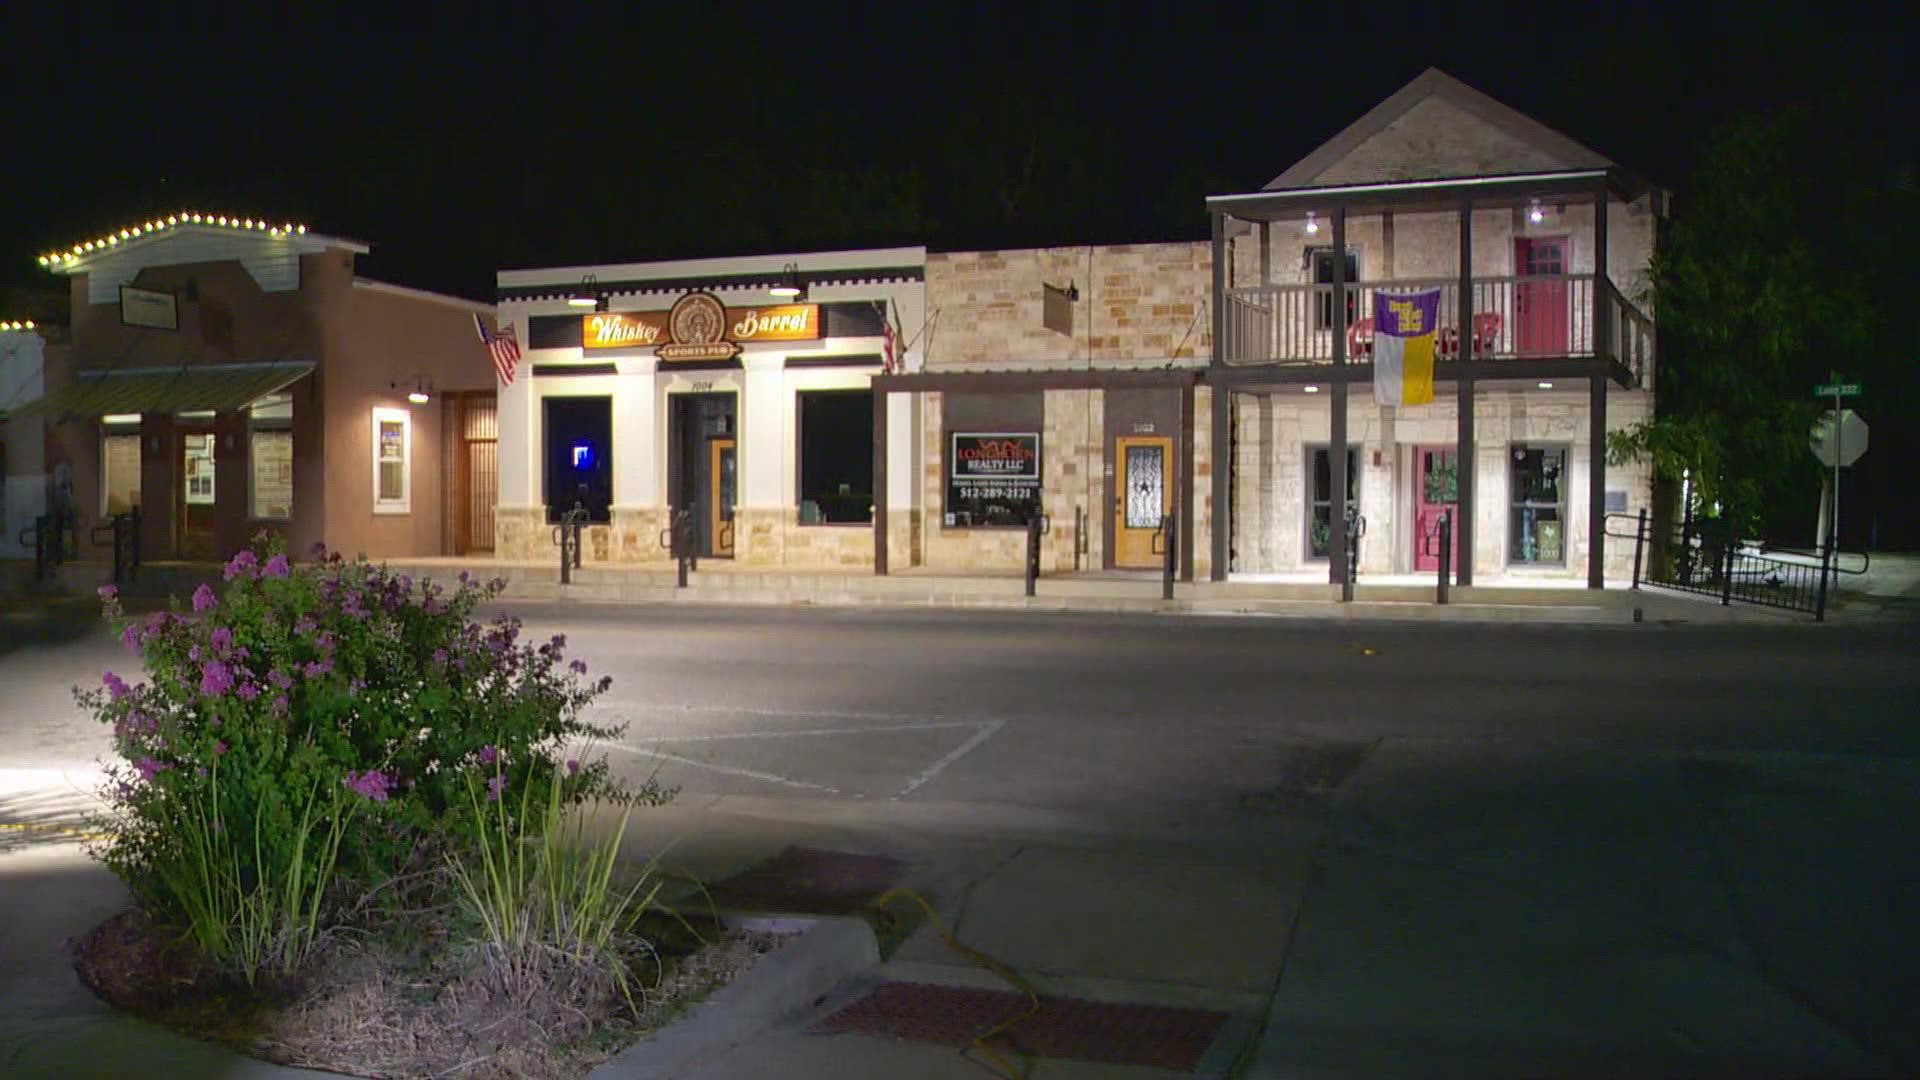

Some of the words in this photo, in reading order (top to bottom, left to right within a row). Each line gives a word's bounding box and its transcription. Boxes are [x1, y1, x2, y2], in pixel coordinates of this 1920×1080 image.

[591, 315, 661, 344] Whiskey
[734, 308, 809, 338] Barrel
[667, 346, 706, 356] SPORTS
[707, 345, 729, 354] PUB
[967, 459, 1004, 470] REALTY
[1005, 459, 1024, 470] LLC
[959, 487, 1032, 499] 512-289-2121
